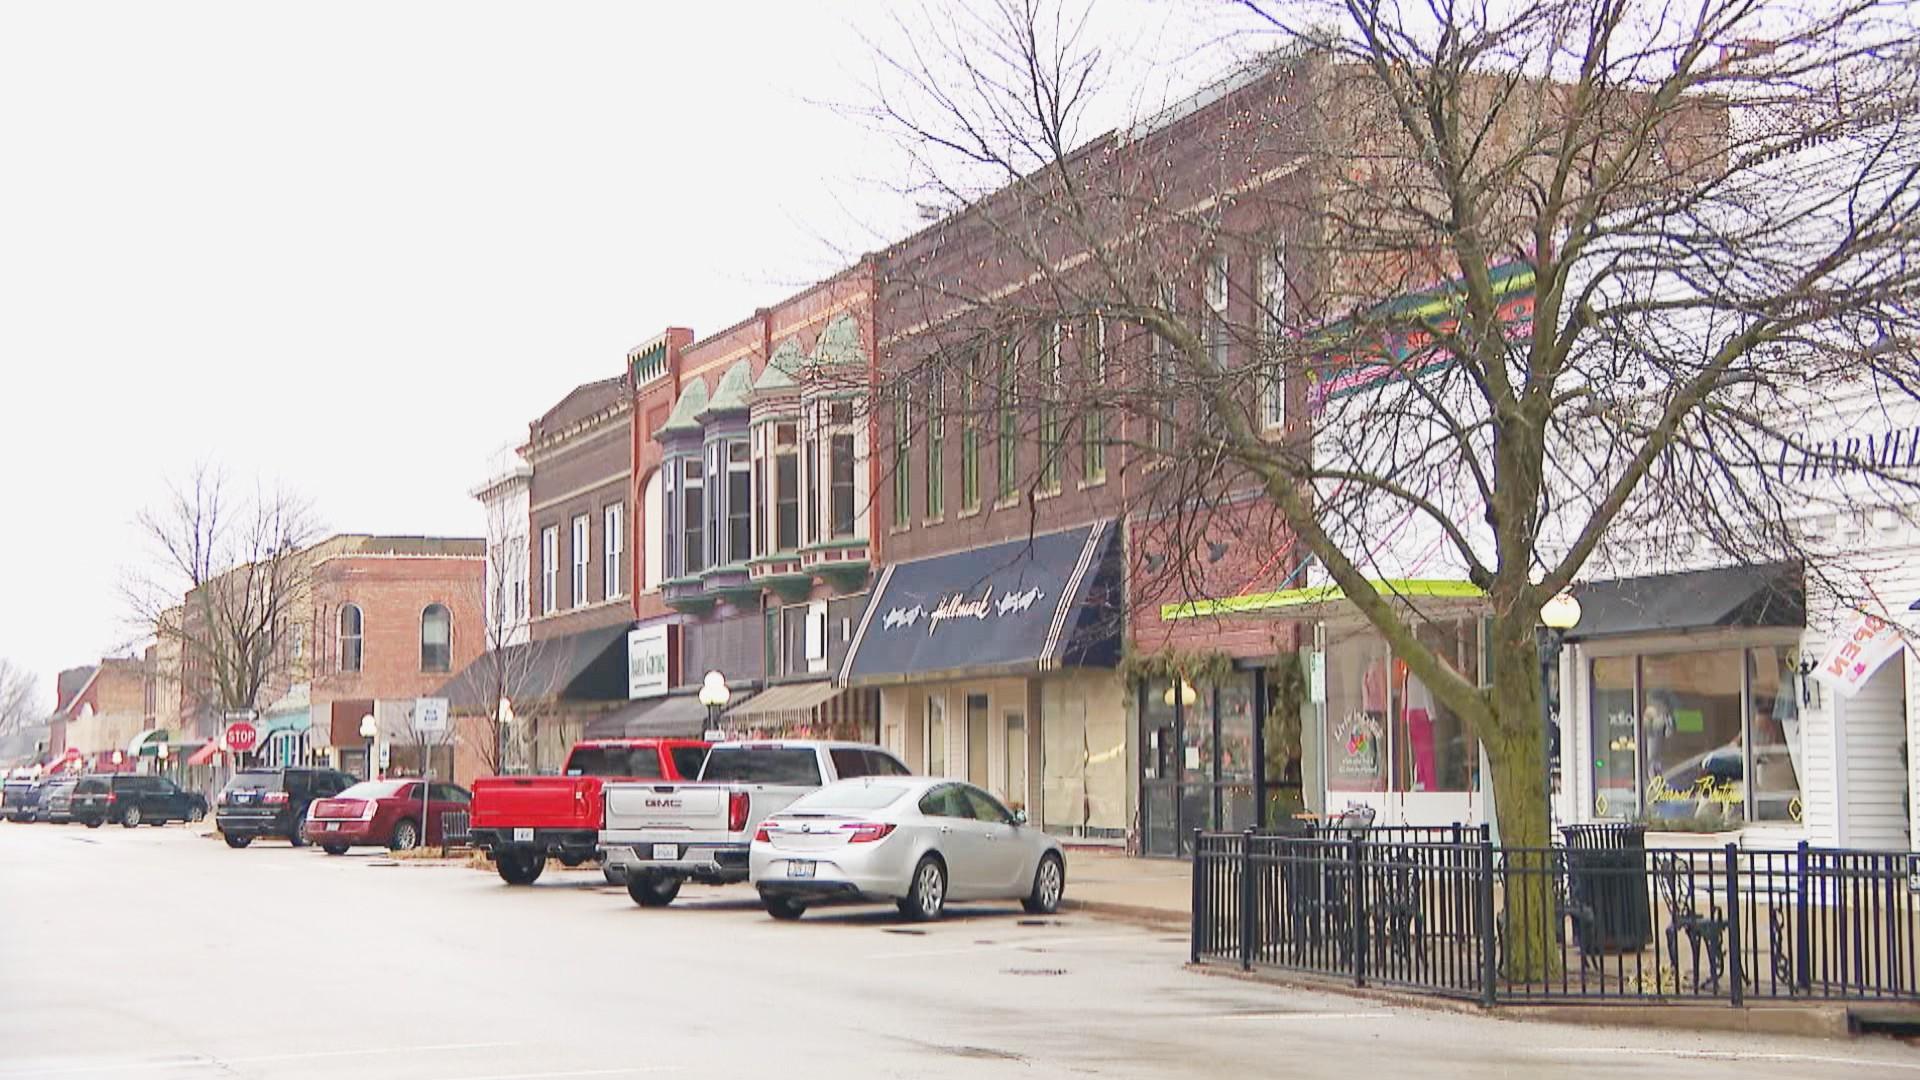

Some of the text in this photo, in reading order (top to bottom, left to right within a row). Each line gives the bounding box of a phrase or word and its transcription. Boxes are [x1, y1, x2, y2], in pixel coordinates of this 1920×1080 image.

[1779, 426, 1920, 485] CHARME
[928, 584, 994, 637] Hallmark
[228, 730, 255, 744] STOP
[645, 799, 683, 808] GMC
